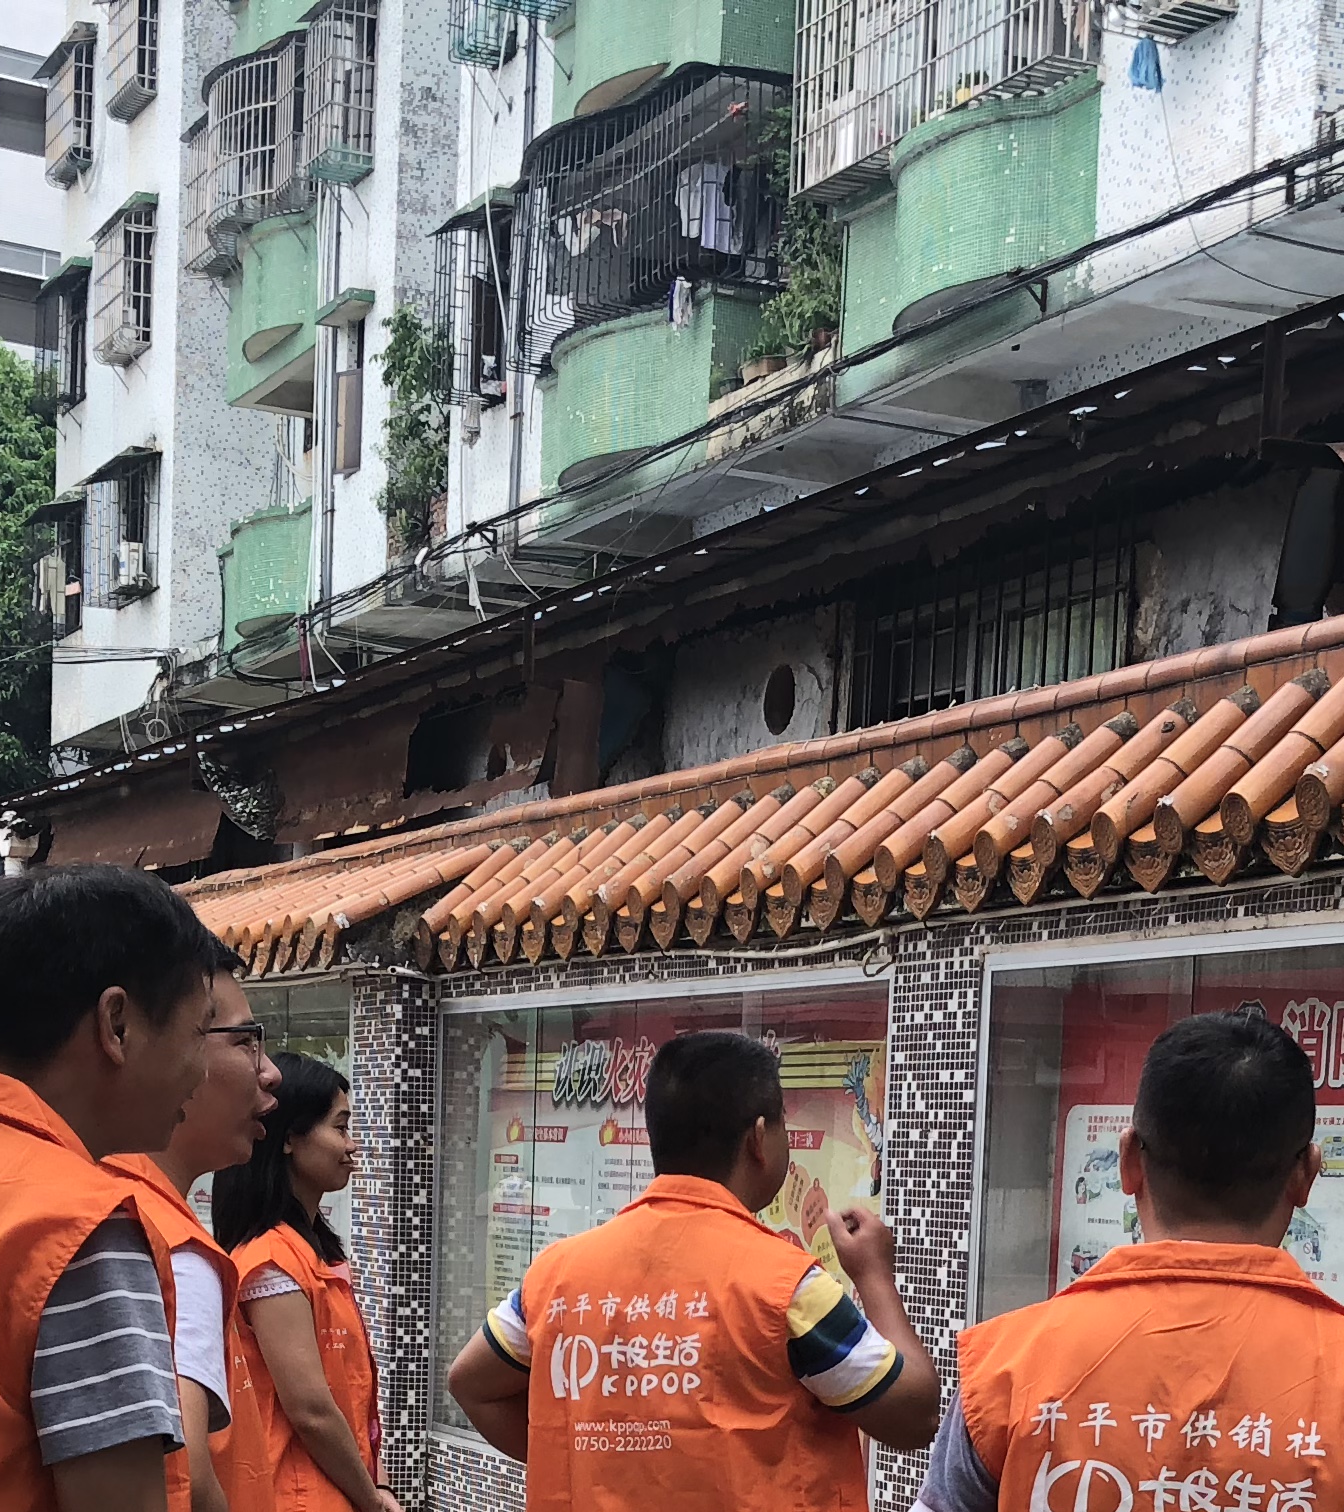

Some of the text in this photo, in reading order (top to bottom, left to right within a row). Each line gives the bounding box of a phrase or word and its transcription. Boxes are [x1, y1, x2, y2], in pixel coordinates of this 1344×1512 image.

[546, 1289, 709, 1326] 开平市供销社
[600, 1332, 702, 1369] 卡皮生活
[601, 1371, 701, 1397] KPPOP
[574, 1418, 671, 1435] www.kppop.com
[1030, 1401, 1327, 1459] 开平市供销社
[574, 1435, 672, 1452] 0750-2222220
